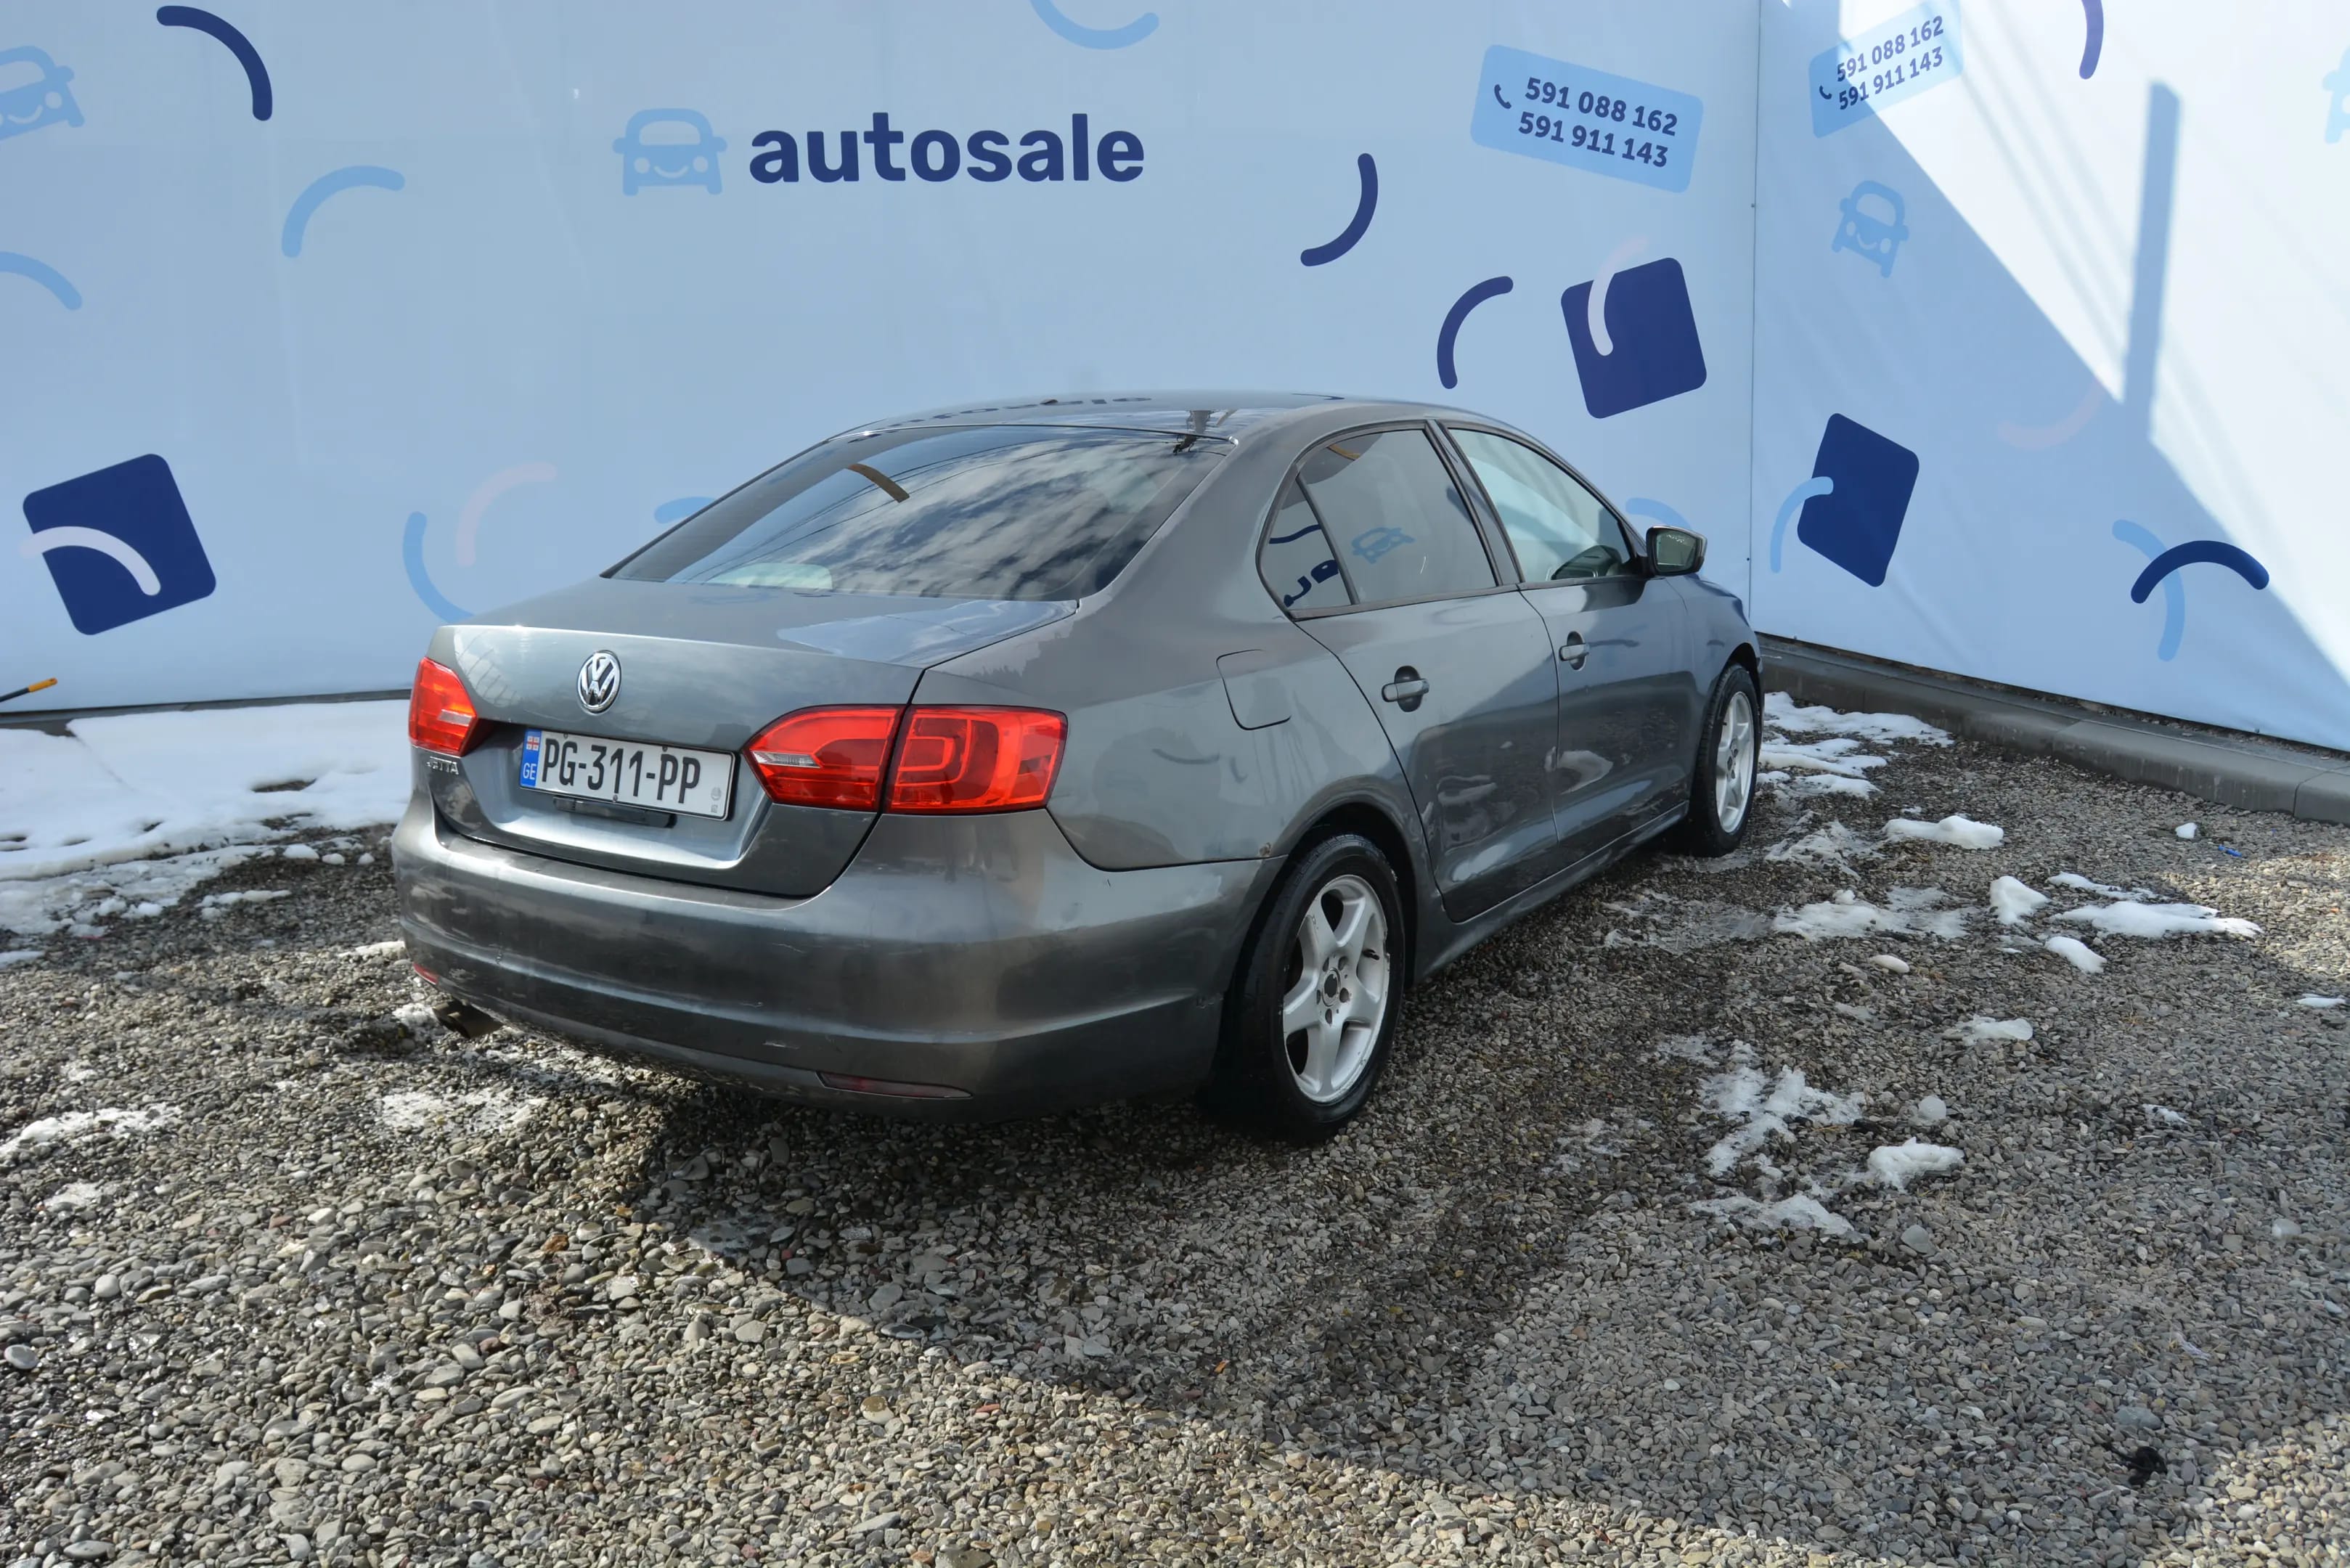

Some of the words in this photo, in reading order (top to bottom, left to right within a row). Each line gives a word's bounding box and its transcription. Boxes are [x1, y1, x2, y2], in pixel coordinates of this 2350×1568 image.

[1837, 53, 1867, 81] 591
[1872, 34, 1905, 65] 088
[1910, 15, 1943, 47] 162
[1839, 81, 1869, 110] 591
[1873, 65, 1905, 94] 911
[1909, 46, 1943, 78] 143
[1525, 77, 1570, 109] 591
[1578, 91, 1627, 122] 088
[1632, 106, 1678, 136] 162
[749, 112, 1144, 183] autosale
[1518, 111, 1564, 142] 591
[1571, 125, 1615, 155] 911
[1622, 138, 1668, 168] 143
[523, 762, 537, 780] GE
[542, 738, 701, 804] PG-311-PP
